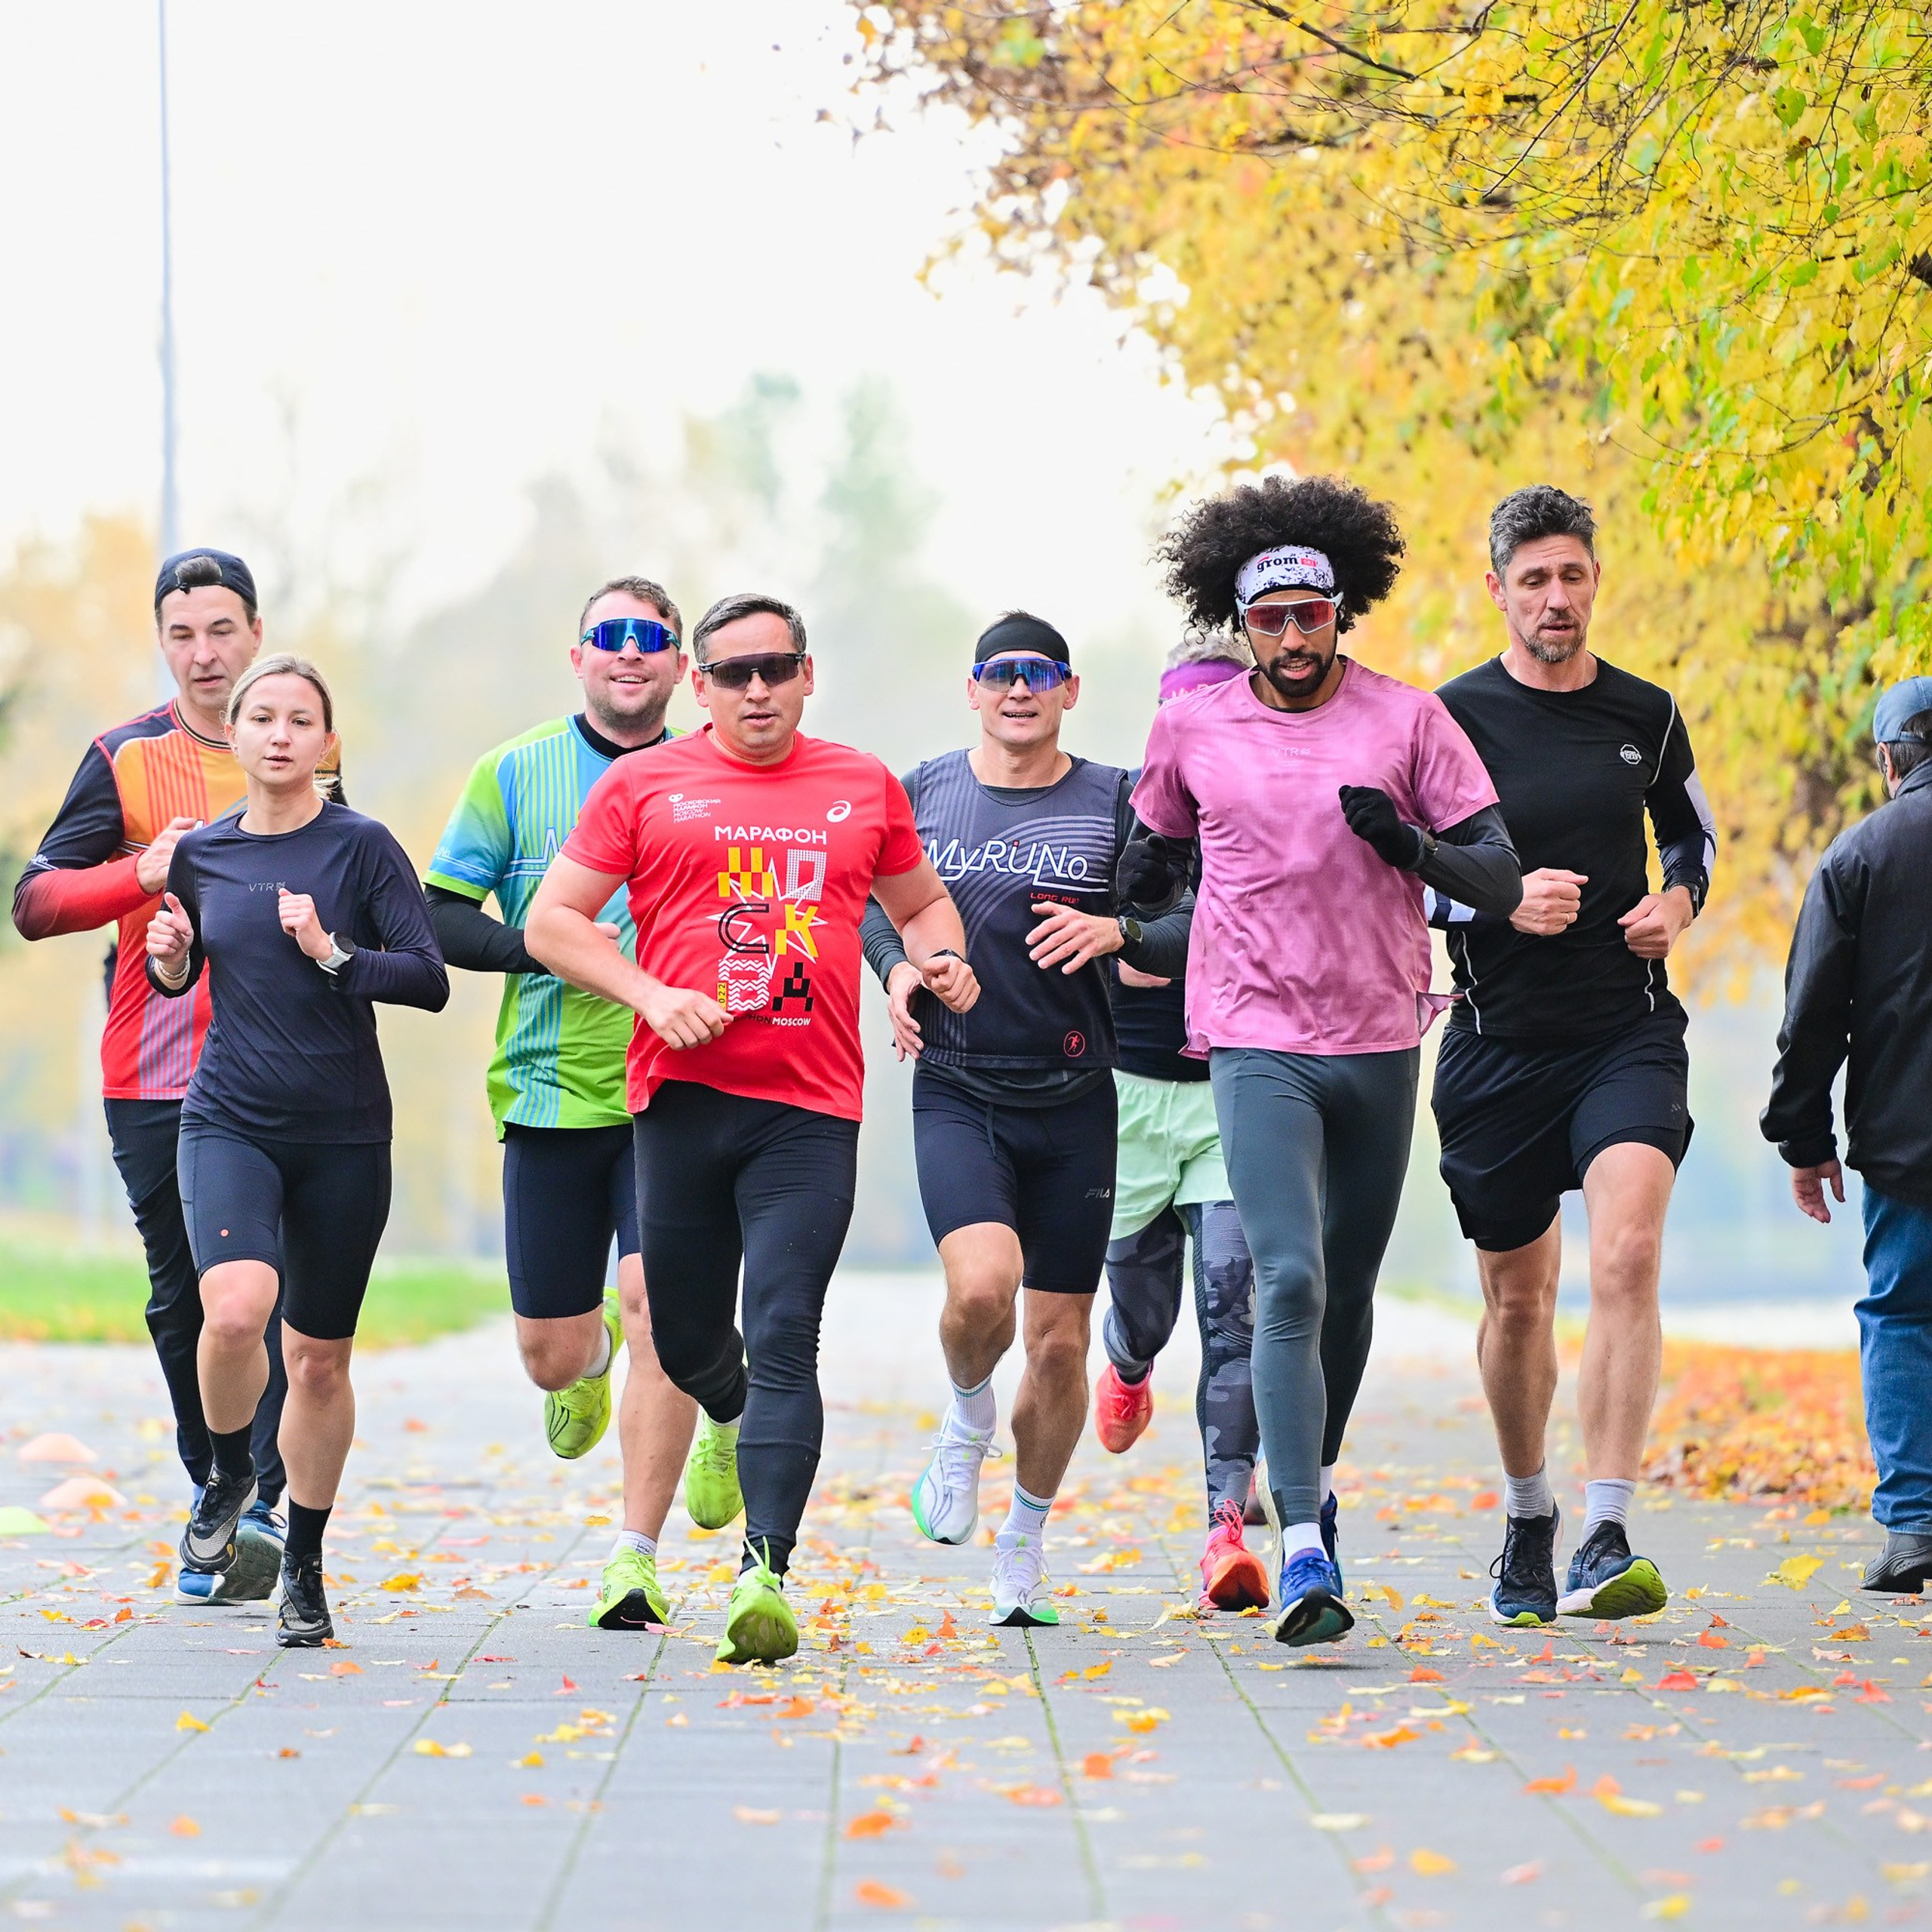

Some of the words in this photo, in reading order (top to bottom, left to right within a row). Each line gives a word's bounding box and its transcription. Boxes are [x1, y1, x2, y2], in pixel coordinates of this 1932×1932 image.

[1257, 557, 1298, 573] grom
[714, 825, 827, 845] МАРАФОН
[718, 983, 726, 1004] 022
